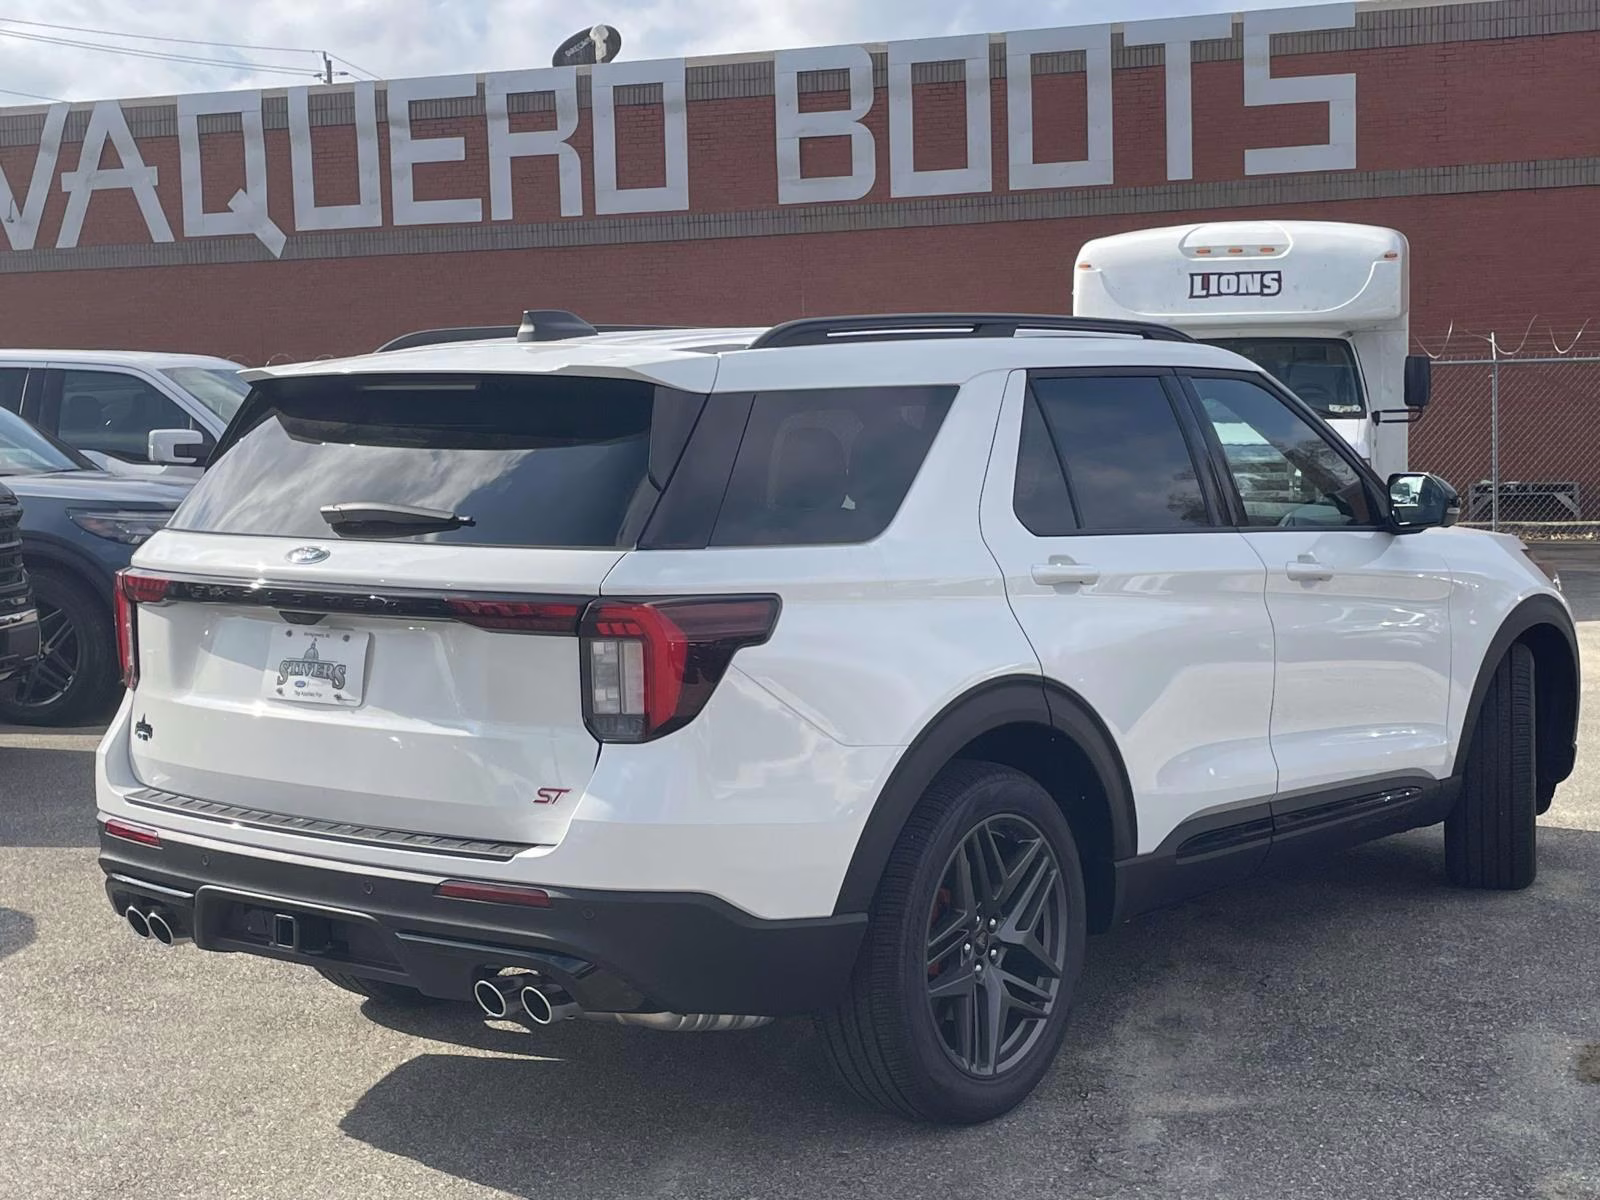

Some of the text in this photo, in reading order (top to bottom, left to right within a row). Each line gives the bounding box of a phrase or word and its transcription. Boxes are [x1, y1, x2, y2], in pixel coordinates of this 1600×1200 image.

[0, 3, 1357, 259] VAQUERO BOOTS
[1189, 271, 1282, 299] LIONS
[276, 660, 347, 690] STIVERS
[533, 787, 572, 805] ST
